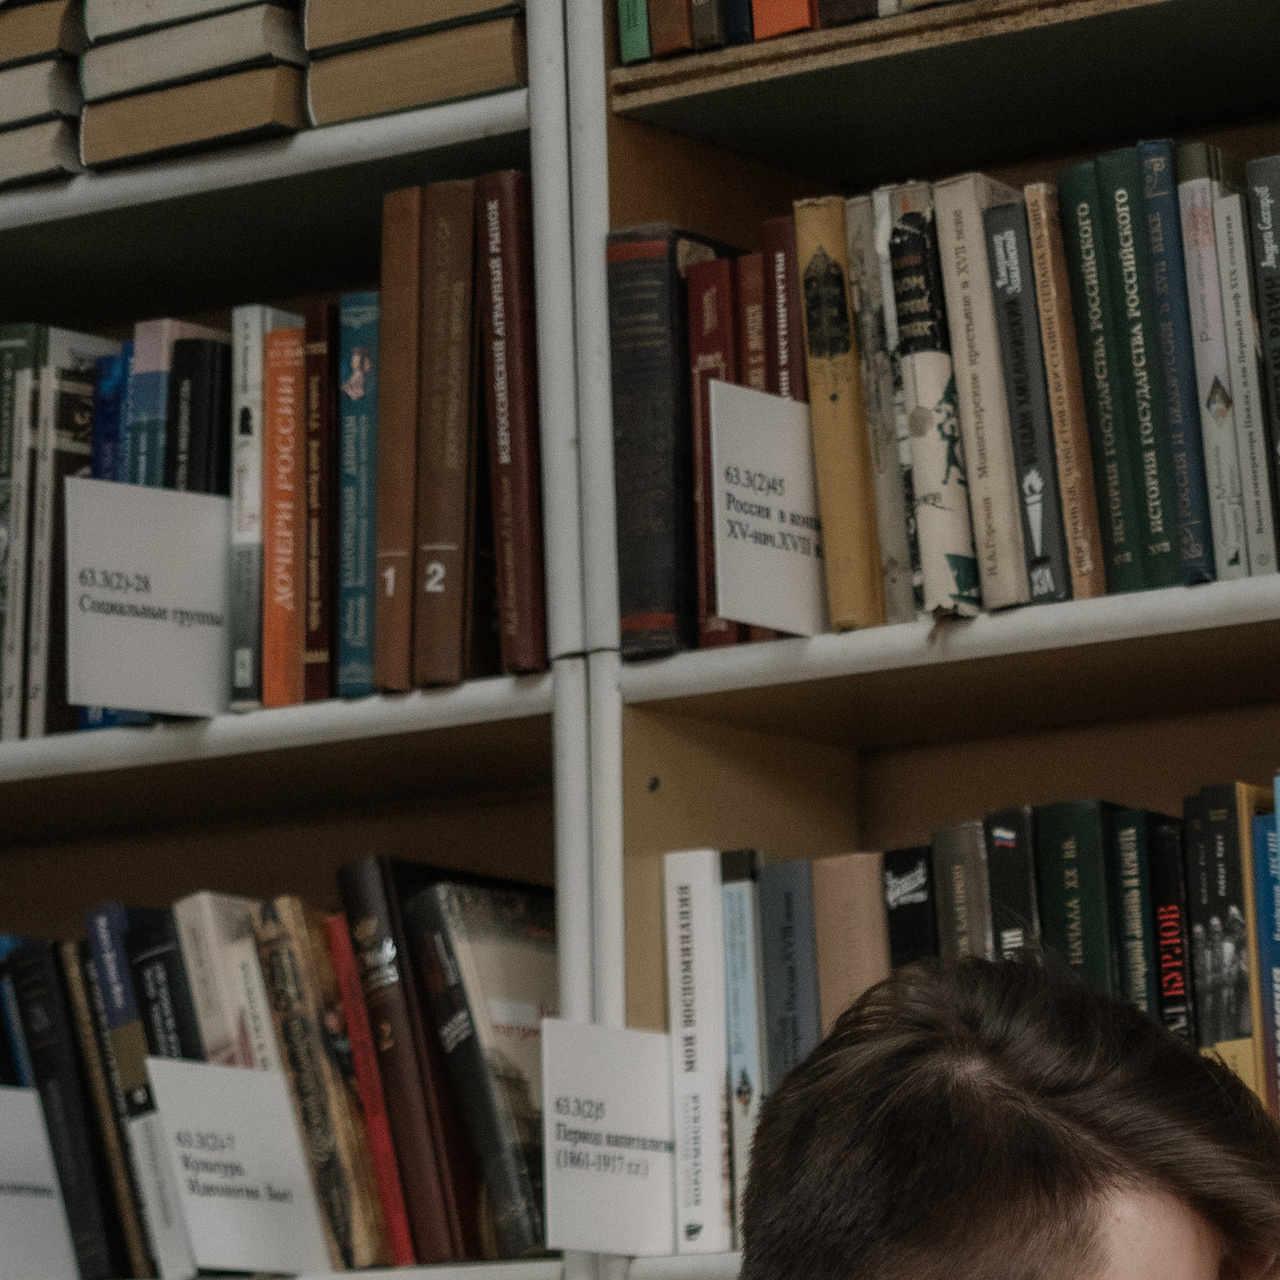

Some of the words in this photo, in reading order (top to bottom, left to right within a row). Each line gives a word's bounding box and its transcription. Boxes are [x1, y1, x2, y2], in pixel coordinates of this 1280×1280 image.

[485, 198, 501, 254] РЫНОК
[1073, 202, 1103, 331] РОССИЙСКОГО
[1111, 188, 1140, 318] РОССИЙСКОГО
[275, 376, 295, 491] РОССИИ
[490, 338, 511, 464] ВСЕРОССИЙСКИЙ
[1089, 336, 1117, 456] ГОСУДАРСТВА
[1127, 322, 1155, 445] ГОСУДАРСТВА
[1104, 461, 1125, 543] ИСТОРИЯ
[1141, 450, 1163, 533] ИСТОРИЯ
[274, 502, 294, 610] ДОЧЕРИ
[383, 567, 395, 596] 1
[425, 563, 446, 592] 2
[677, 885, 696, 1027] ВОСПОМИНАНИЯ
[1155, 904, 1185, 997] КУРЛОВ
